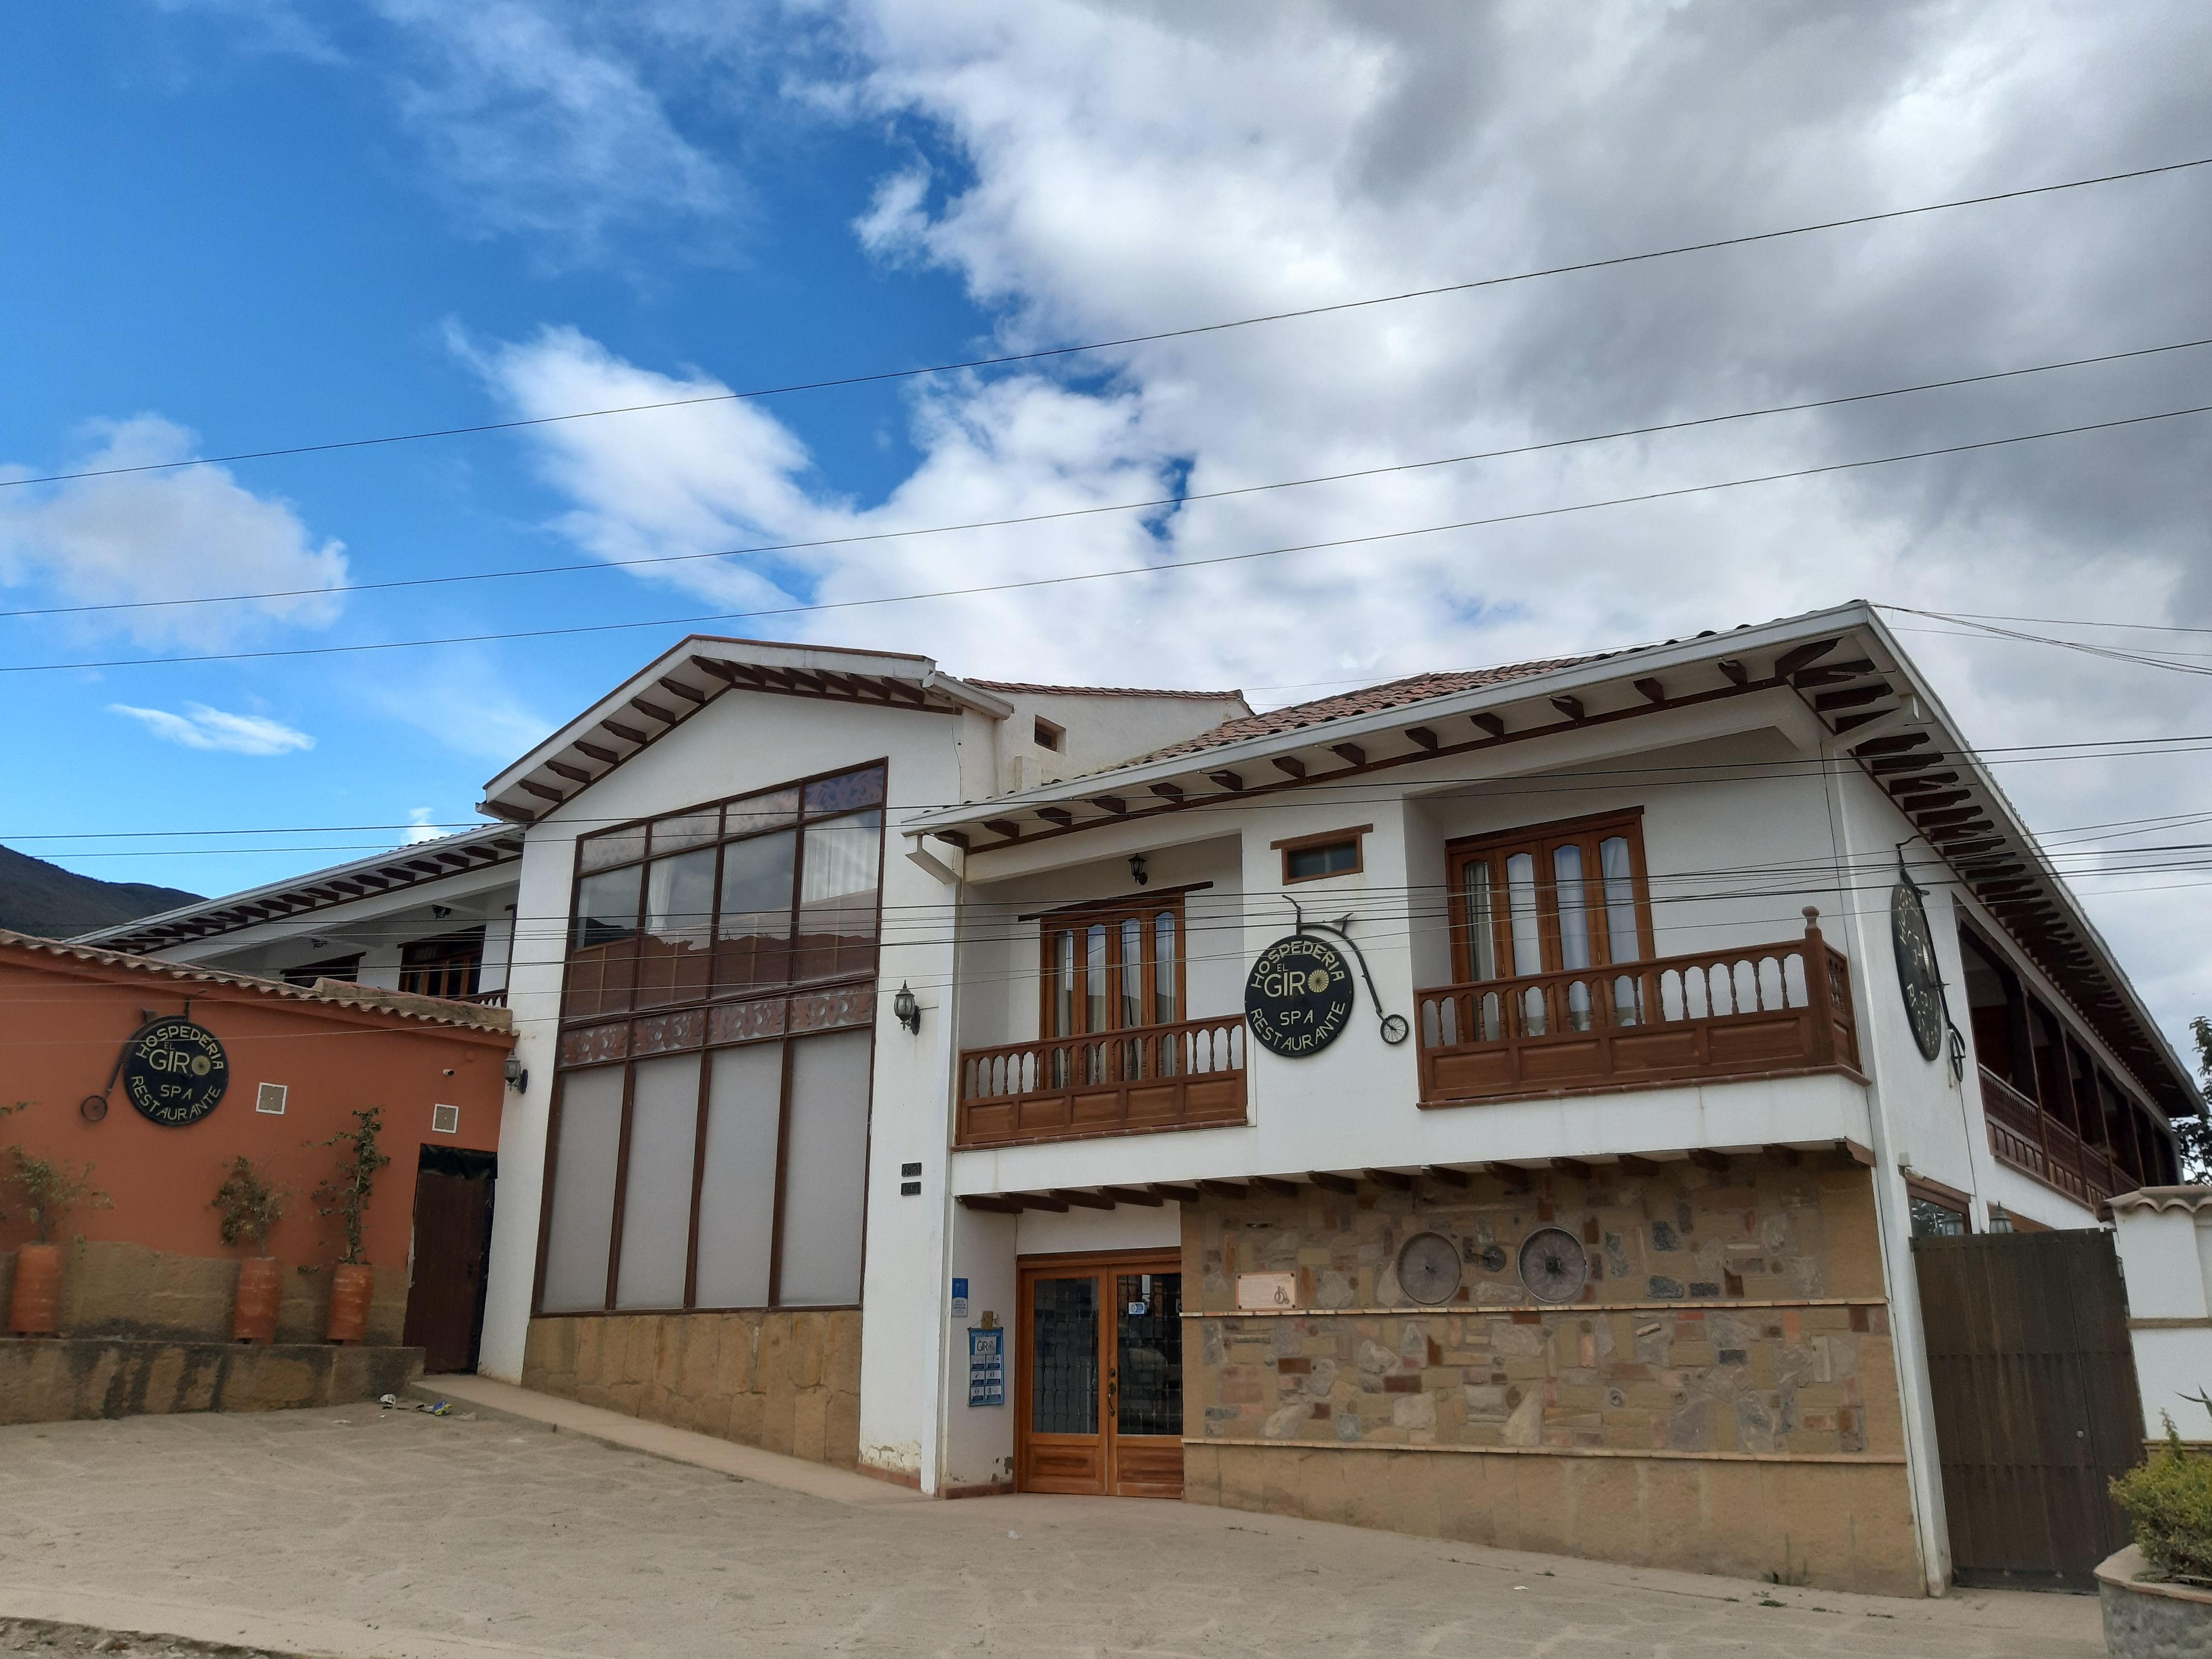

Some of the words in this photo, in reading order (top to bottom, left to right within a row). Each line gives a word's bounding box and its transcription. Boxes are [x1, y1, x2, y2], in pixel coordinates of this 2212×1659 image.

[1250, 940, 1345, 988] HOSPEDERIA
[1277, 963, 1289, 972] EL
[1250, 1001, 1346, 1051] RESTAURANTE
[1279, 1009, 1313, 1026] SPA
[135, 1025, 224, 1070] HOSPEDERIA
[164, 1041, 175, 1050] EL
[131, 1075, 221, 1120] RESTAURANTE
[160, 1084, 193, 1100] SPA
